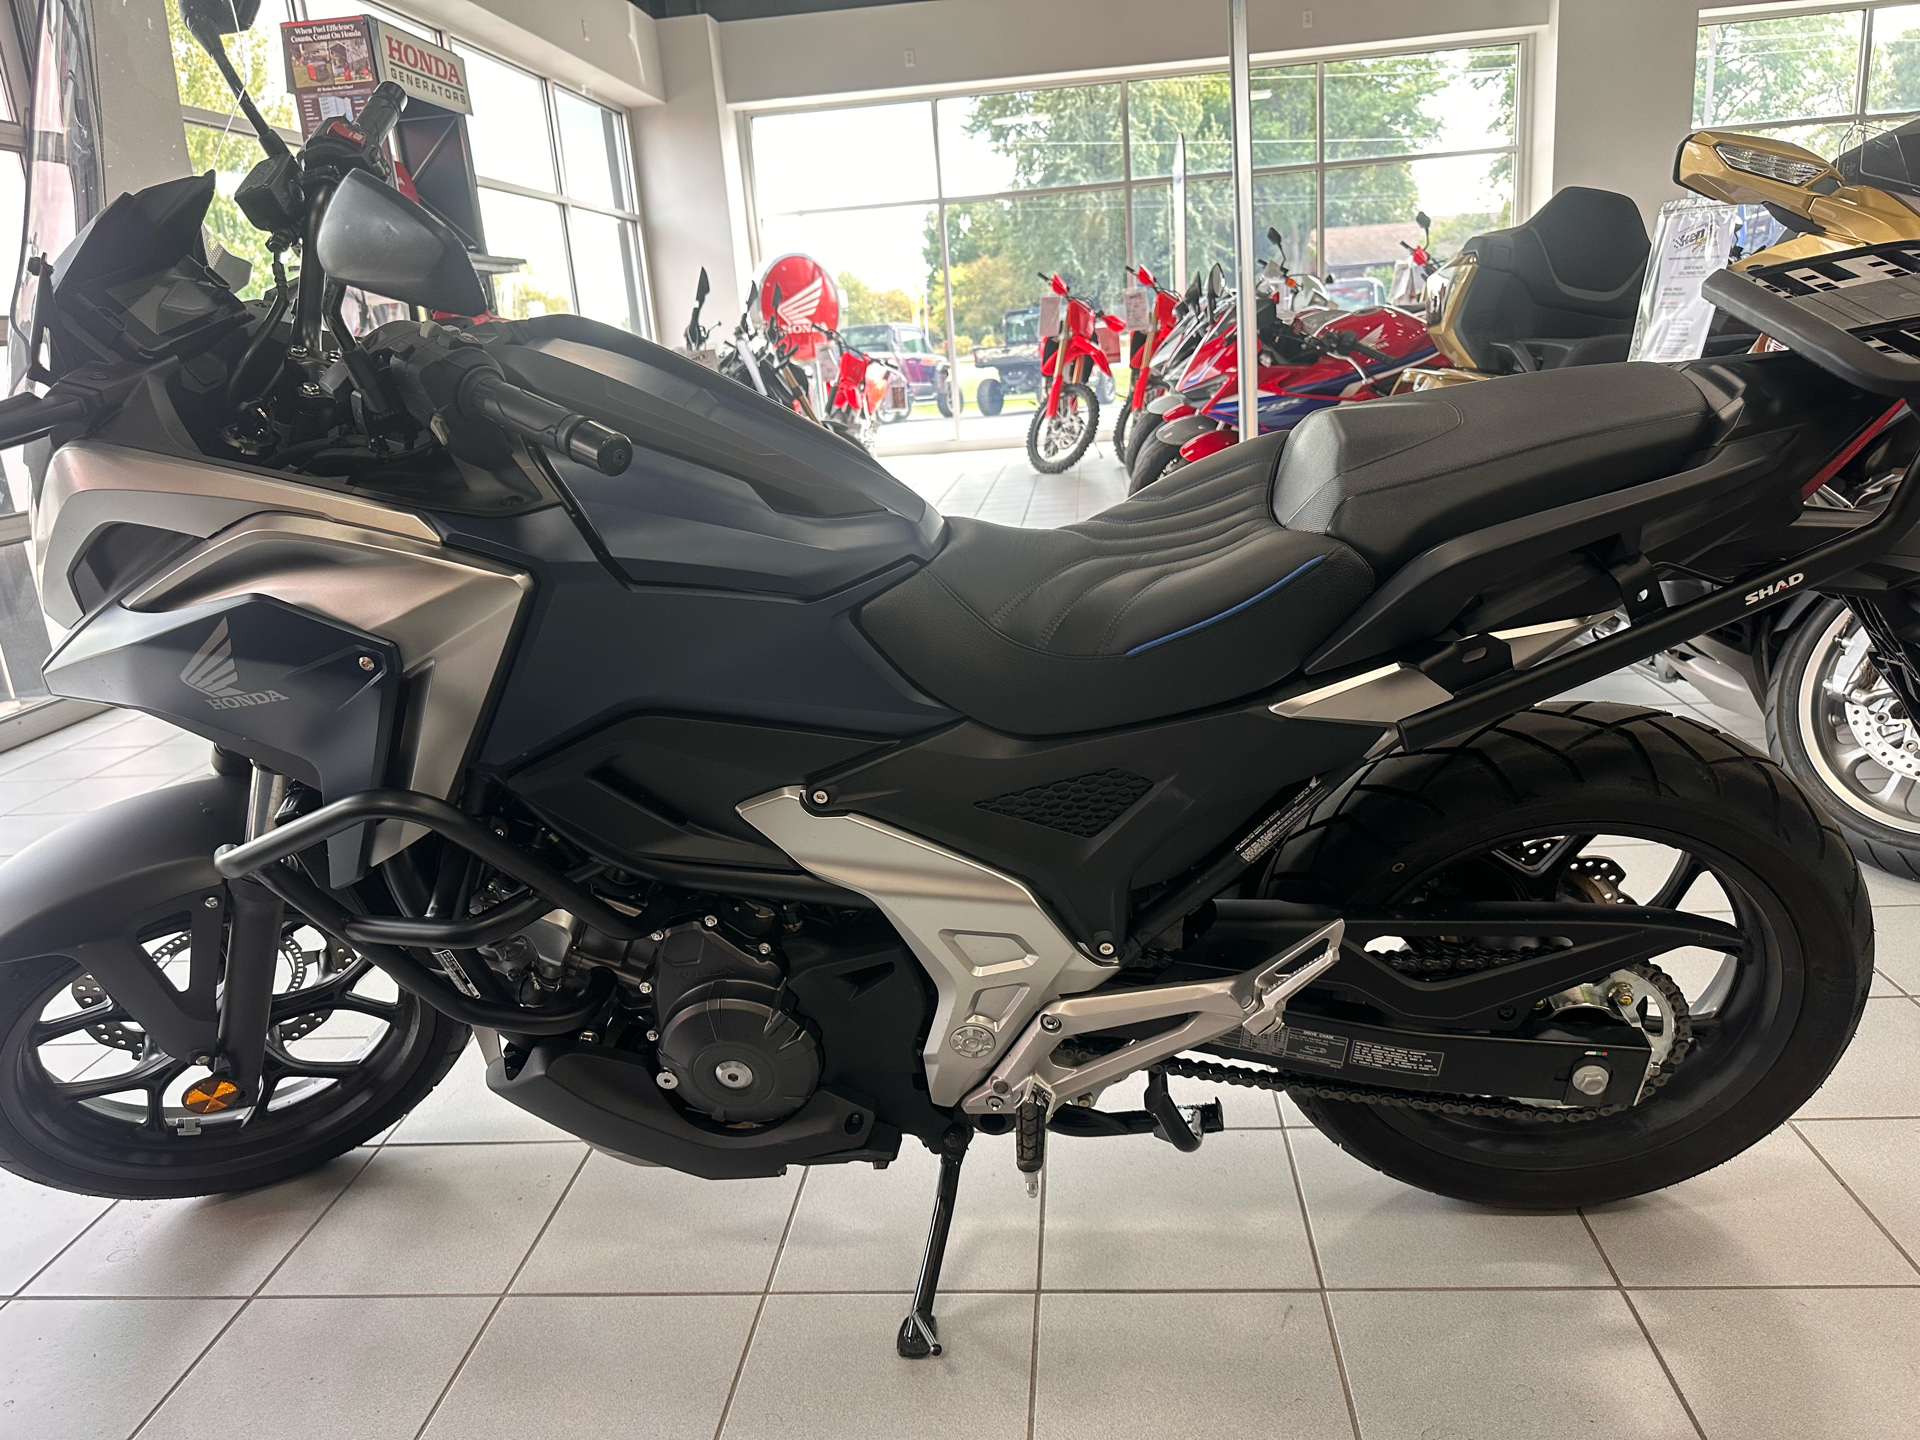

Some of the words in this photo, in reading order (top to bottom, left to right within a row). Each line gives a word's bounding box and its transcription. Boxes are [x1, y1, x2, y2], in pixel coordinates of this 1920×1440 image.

[290, 35, 313, 43] Counts,
[313, 33, 331, 41] Count
[341, 29, 361, 38] Honda
[294, 27, 312, 35] When
[312, 25, 326, 34] Fuel
[326, 23, 354, 32] Efficiency
[385, 35, 463, 87] HONDA
[391, 67, 466, 105] GENERATORS
[1744, 572, 1804, 606] SHAD
[205, 689, 290, 710] HONDA
